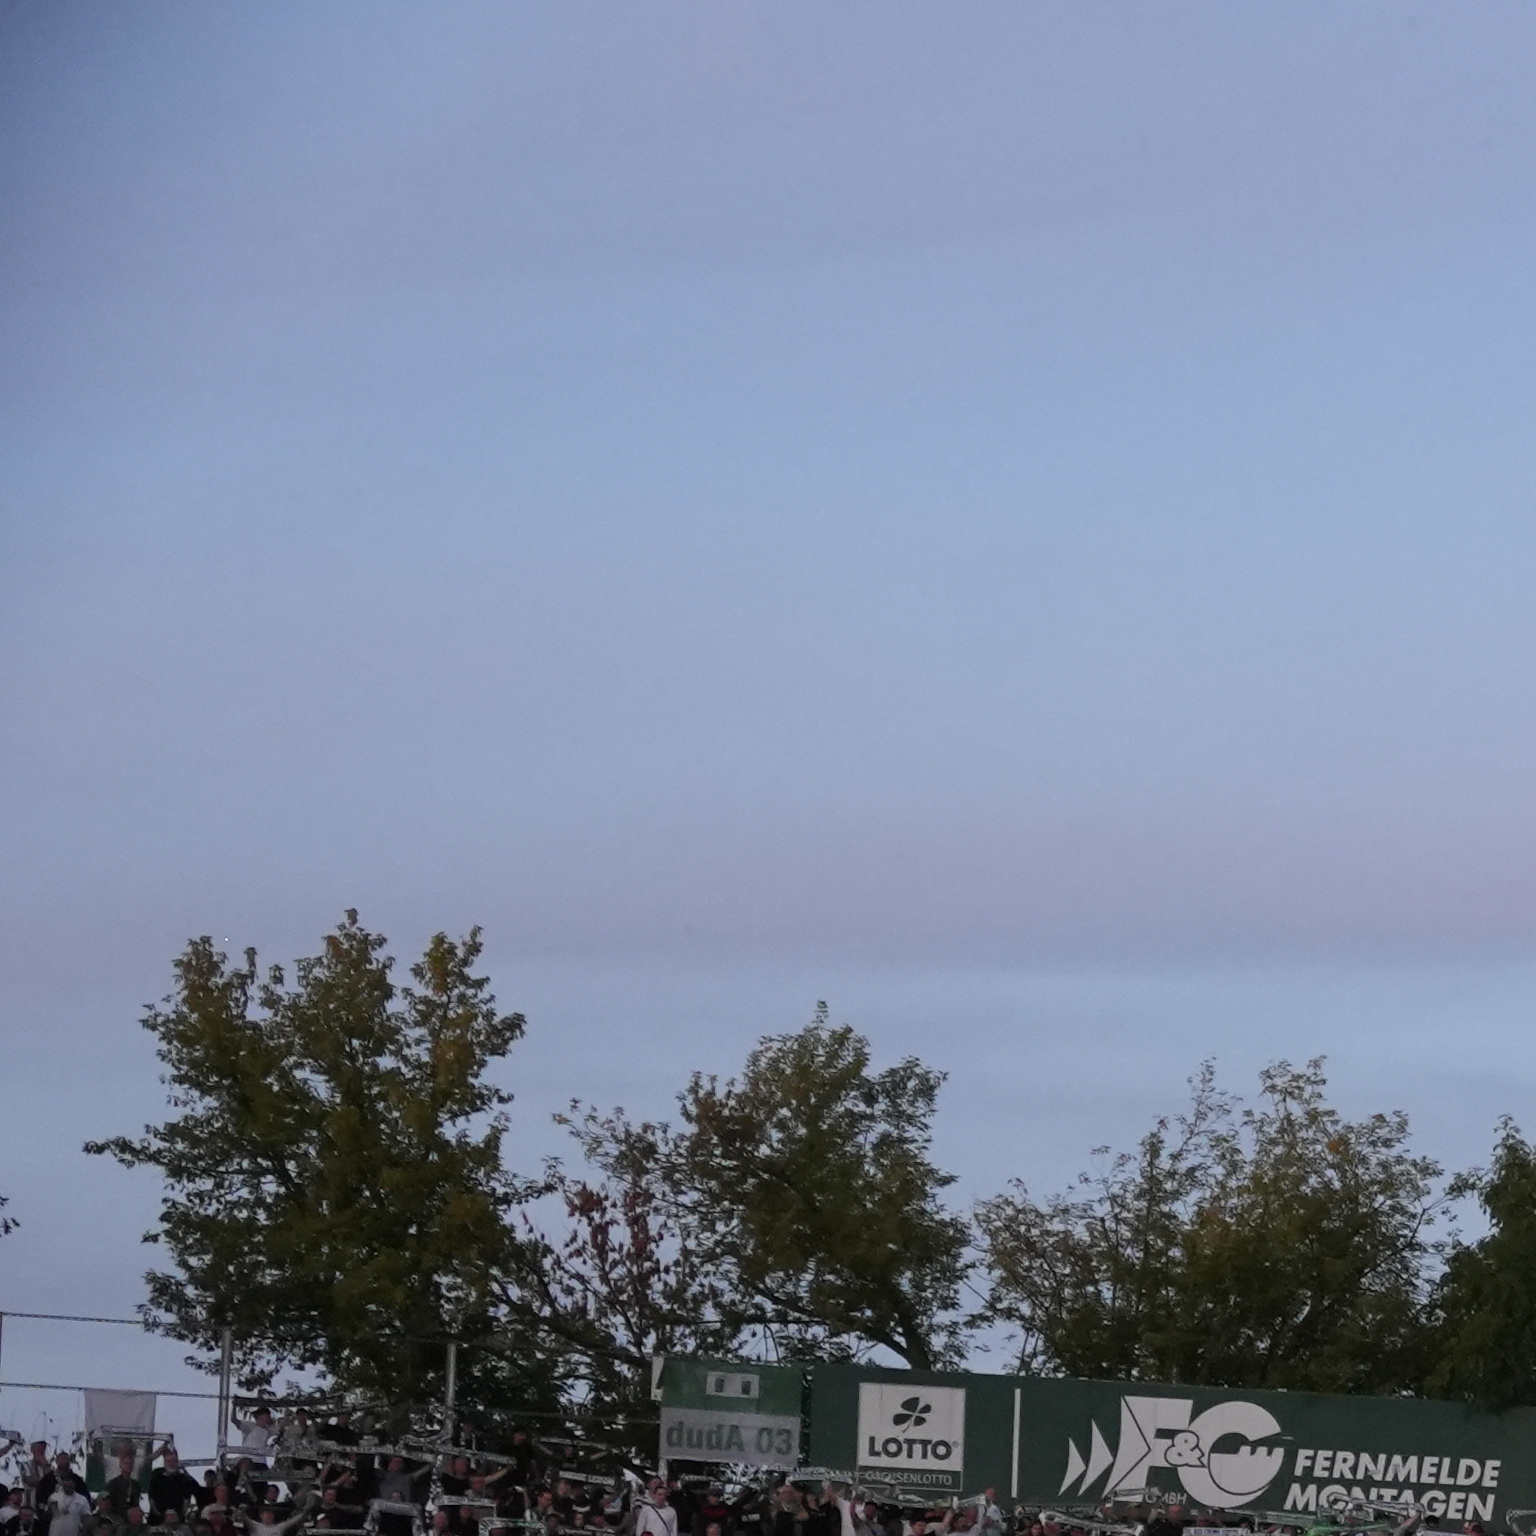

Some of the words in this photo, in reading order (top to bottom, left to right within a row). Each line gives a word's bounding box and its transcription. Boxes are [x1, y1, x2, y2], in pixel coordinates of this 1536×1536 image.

[868, 1435, 953, 1462] LOTTO
[1294, 1448, 1502, 1488] FERNMELDE
[1283, 1483, 1496, 1522] MONTAGEN
